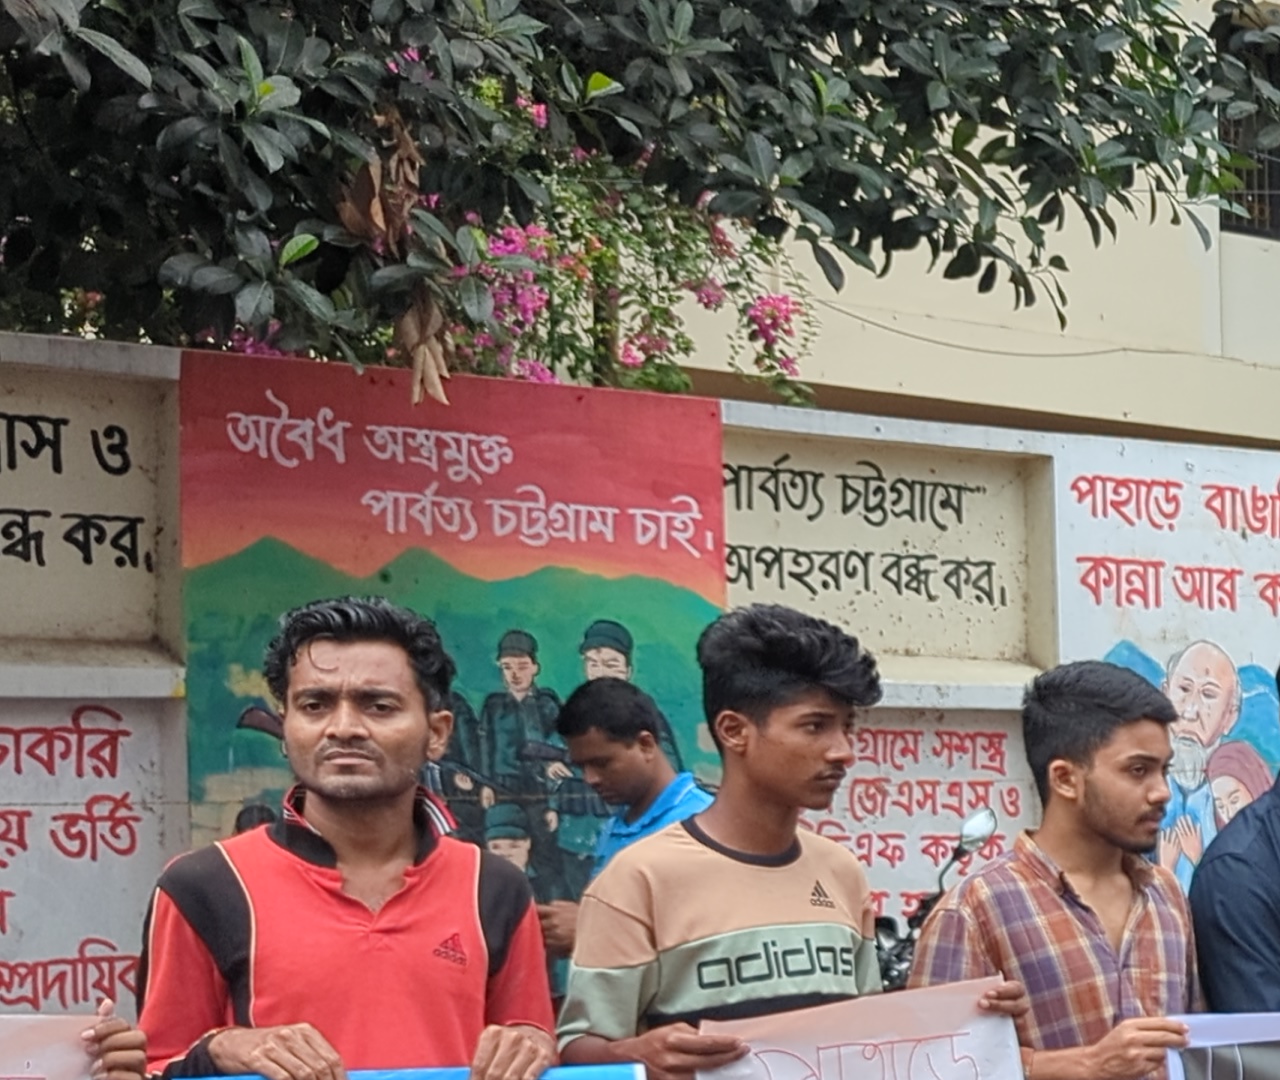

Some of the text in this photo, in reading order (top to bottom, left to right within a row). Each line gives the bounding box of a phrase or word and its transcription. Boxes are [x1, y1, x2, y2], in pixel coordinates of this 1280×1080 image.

[0, 411, 131, 475] াস ও
[226, 390, 514, 485] অবৈধ অস্ত্রমুক্ত
[361, 481, 479, 542] পার্বত্য
[486, 485, 620, 548] চট্টগ্রাম
[723, 455, 982, 531] পার্বত্য চট্টগ্রামে
[1070, 473, 1185, 533] পাহাড়ে
[724, 543, 874, 598] অপহরণ
[882, 551, 939, 601] বন্ধ
[1076, 555, 1165, 610] কান্না
[1171, 564, 1243, 614] আর
[933, 729, 1007, 777] সশস্ত্র
[50, 791, 143, 862] ভর্তি
[1001, 786, 1021, 818] ও
[697, 938, 854, 990] adidas
